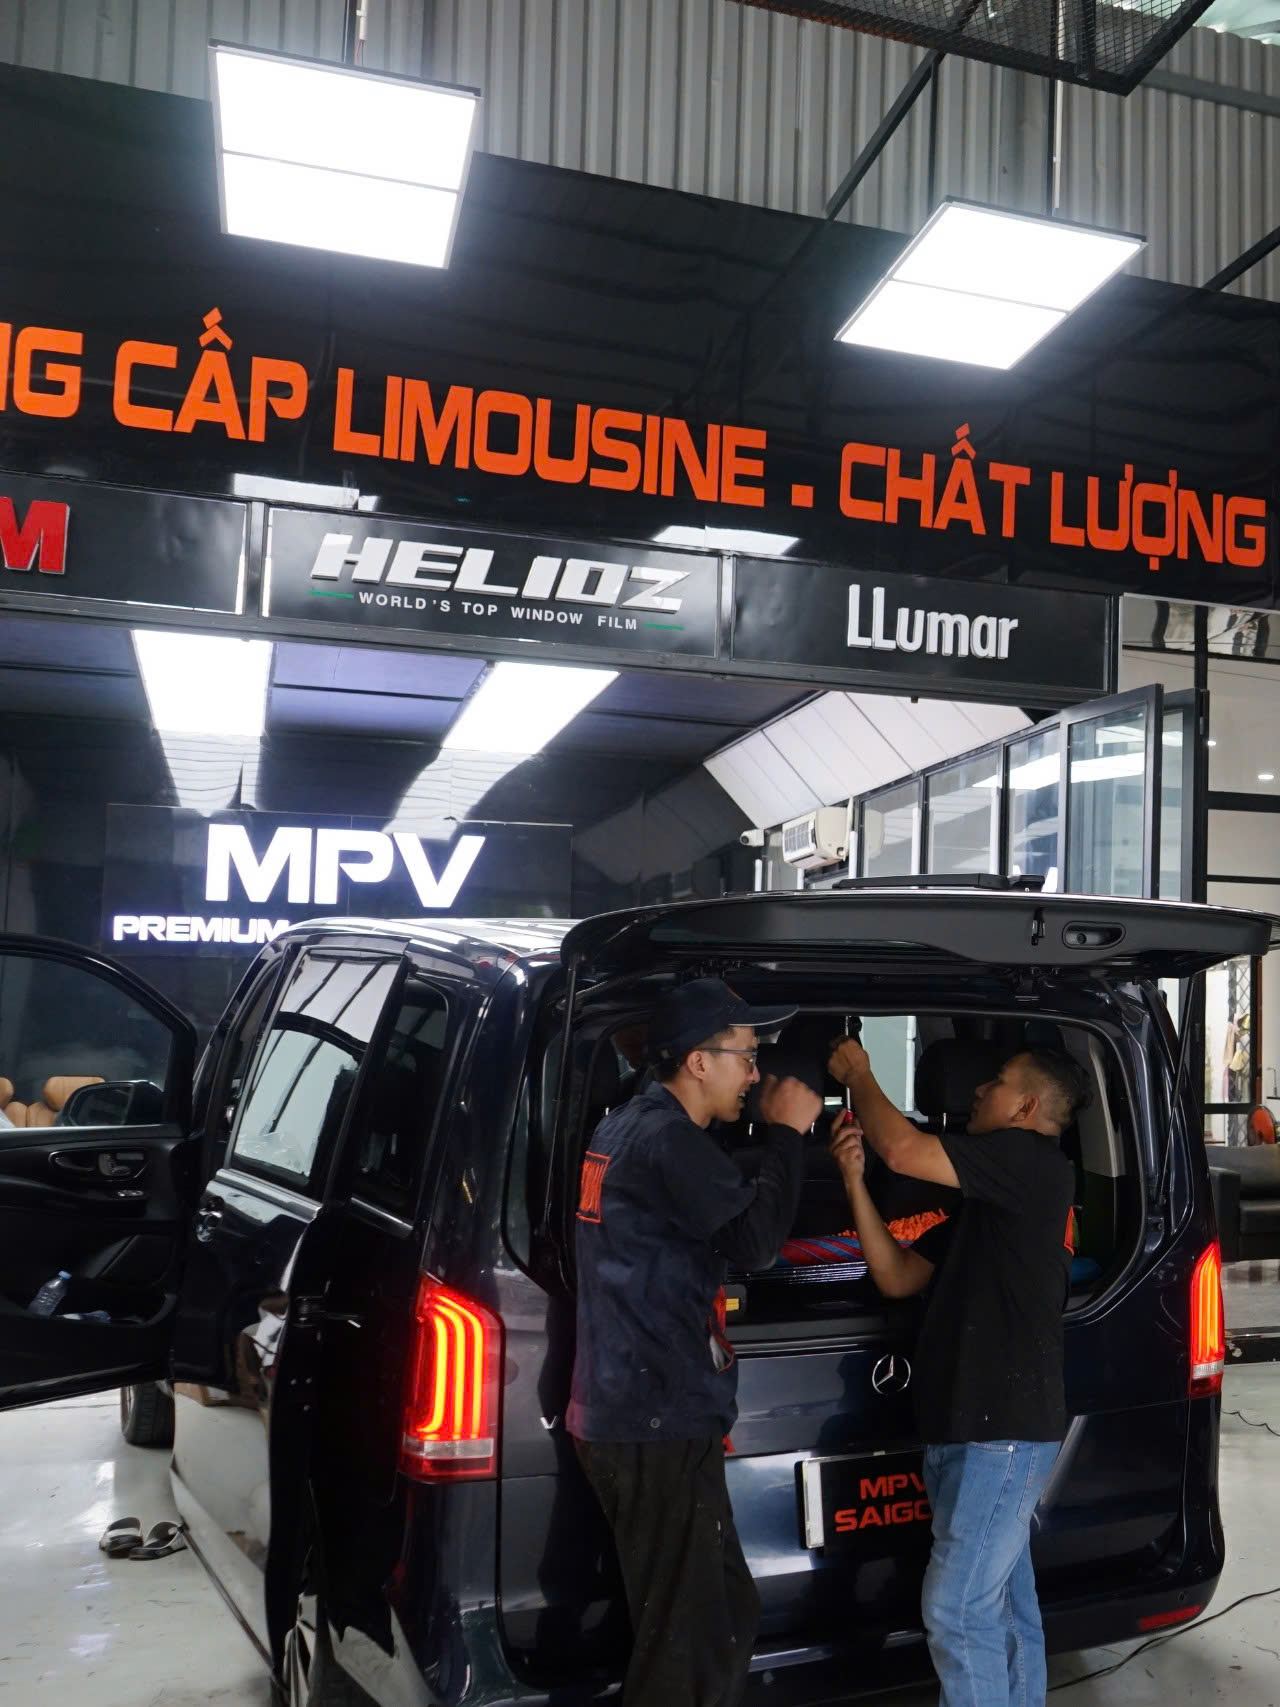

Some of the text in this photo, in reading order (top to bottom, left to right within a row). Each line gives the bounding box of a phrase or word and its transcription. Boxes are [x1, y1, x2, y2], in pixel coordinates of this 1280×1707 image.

[113, 307, 309, 444] CẤP
[333, 368, 768, 508] LIMOUSINE
[840, 423, 1032, 538] CHẤT
[1051, 464, 1267, 571] LƯỢNG
[311, 533, 691, 615] HELIOZ
[359, 591, 638, 630] WORLD'S TOP WINDOW FILM
[847, 583, 1019, 659] LLumar
[205, 823, 486, 908] MPV
